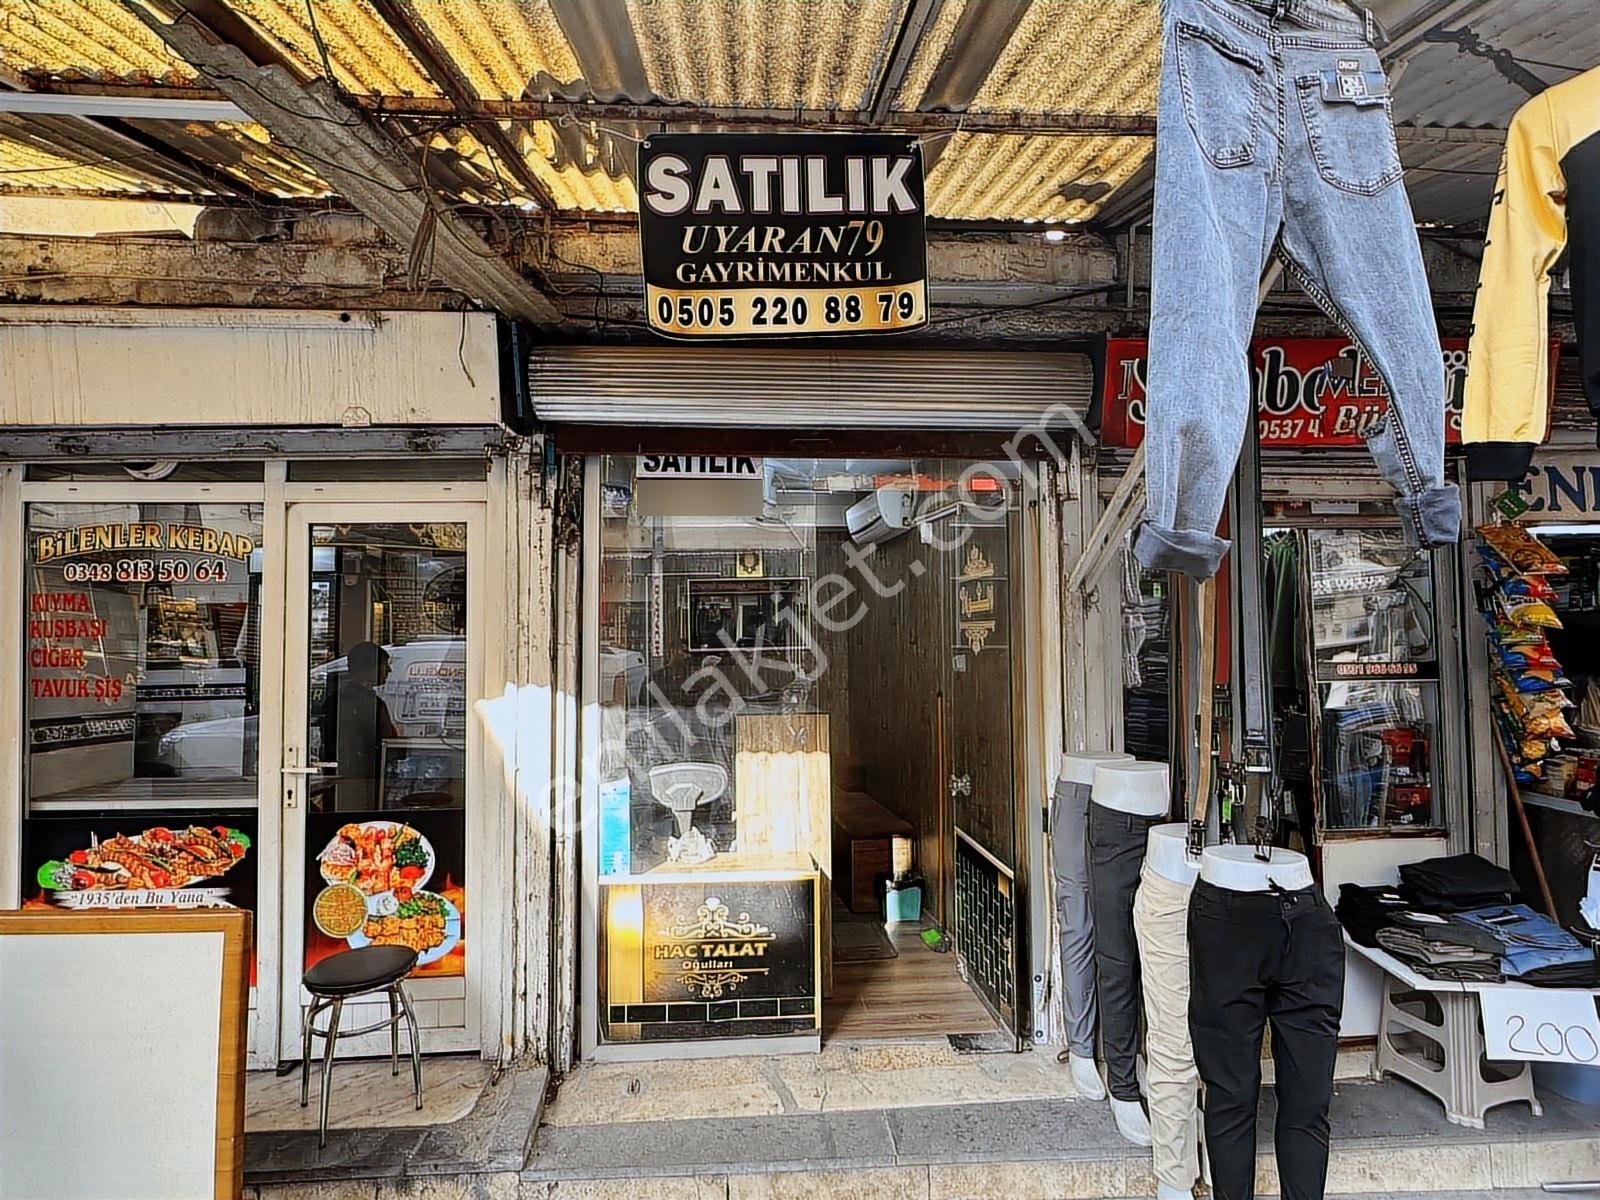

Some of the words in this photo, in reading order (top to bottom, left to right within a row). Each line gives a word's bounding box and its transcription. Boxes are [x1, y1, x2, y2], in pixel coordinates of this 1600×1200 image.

[646, 155, 918, 214] SATILIK
[676, 257, 891, 283] GAYRİMENKUL
[657, 294, 737, 328] 0505
[751, 295, 808, 327] 220
[824, 294, 862, 324] 88
[877, 291, 915, 322] 79
[168, 523, 255, 561] KEBAP
[64, 563, 112, 582] 0348
[116, 559, 155, 582] 813
[159, 559, 190, 582] 50
[193, 558, 227, 582] 64
[32, 593, 90, 612] KIYMA
[32, 678, 89, 698] TAVUK
[145, 891, 164, 904] Bu
[655, 944, 698, 959] HAC
[701, 942, 768, 957] TALAT
[1506, 1015, 1599, 1062] 200
